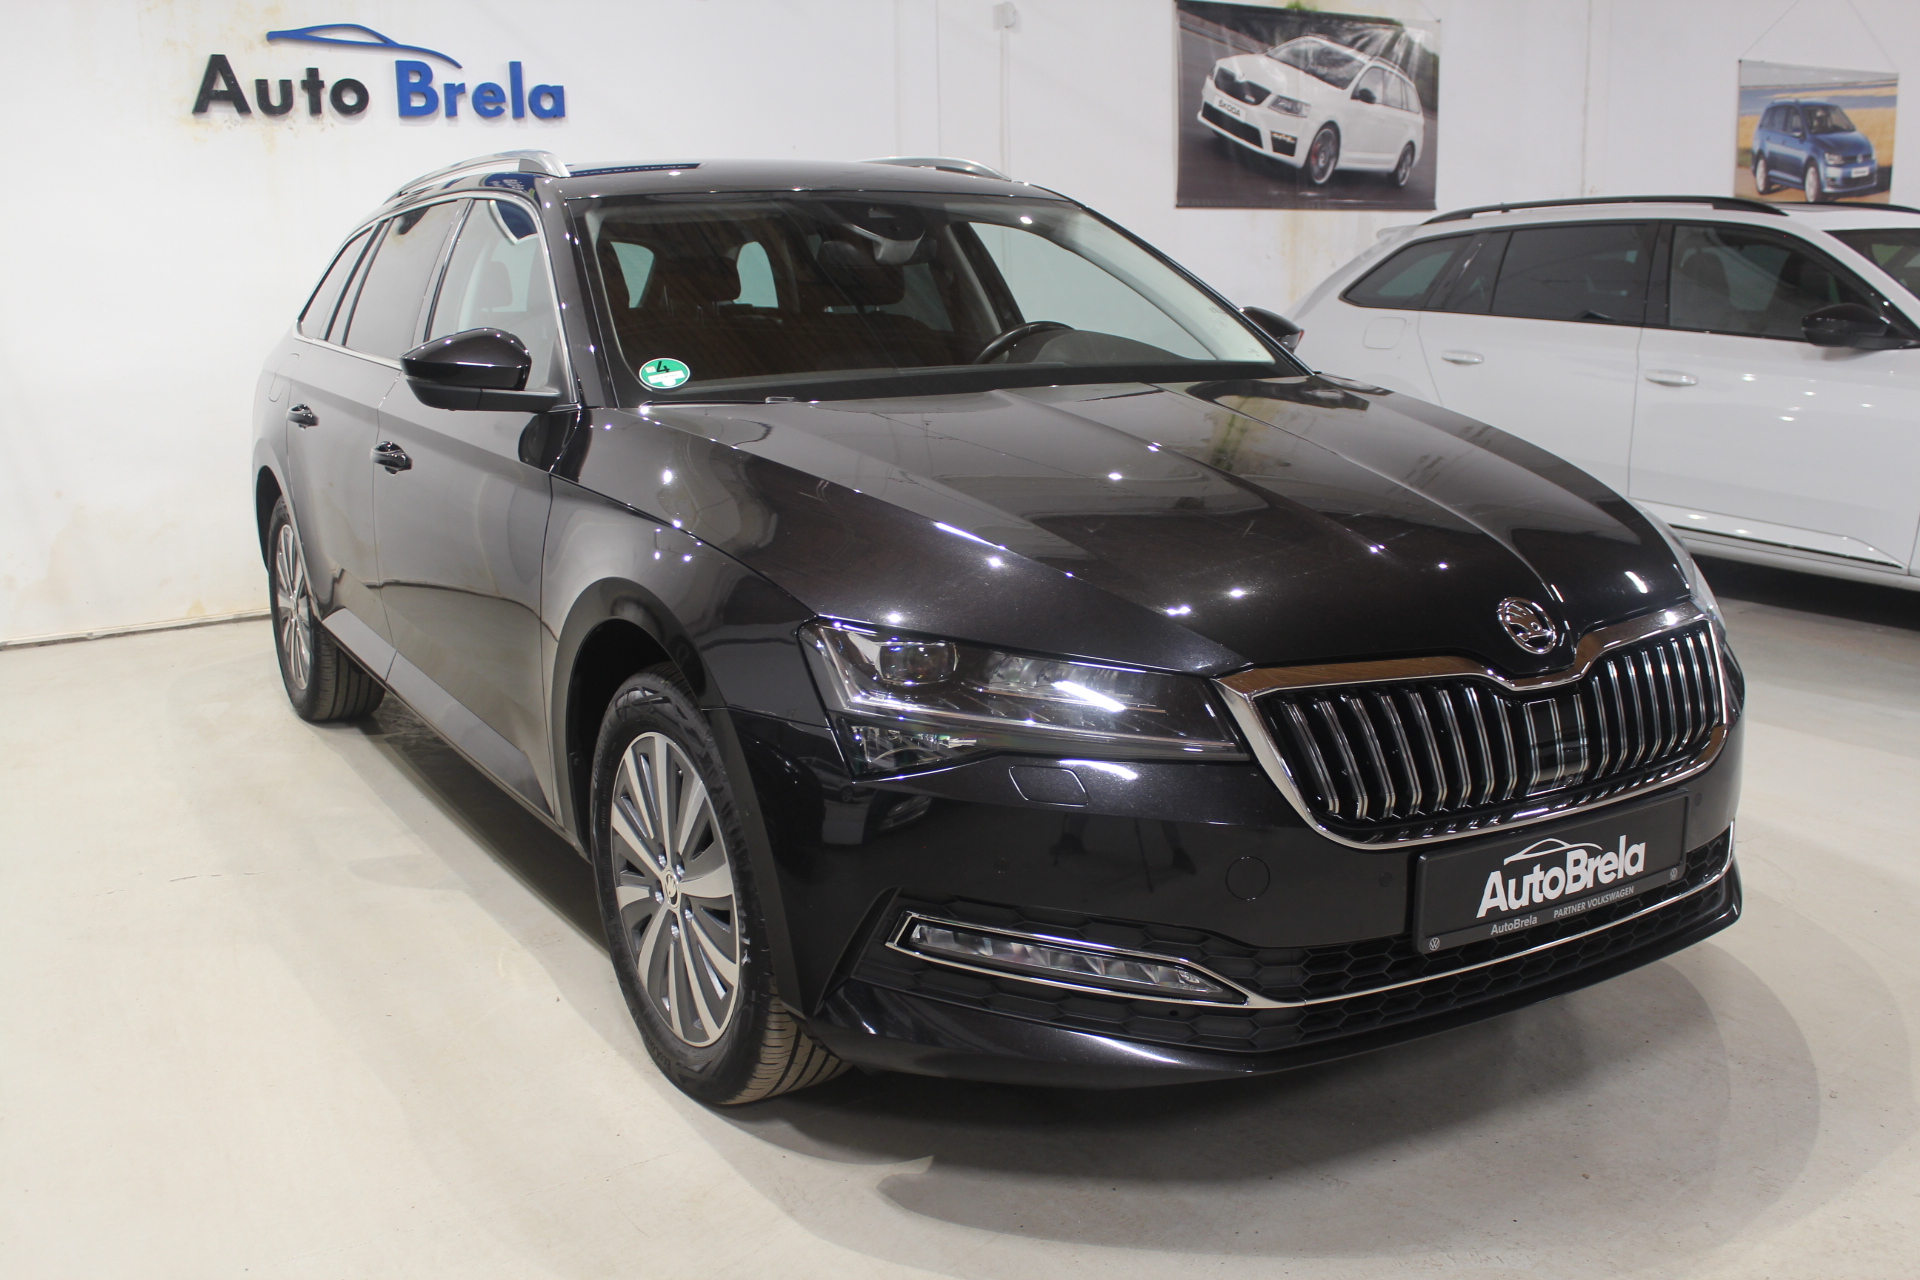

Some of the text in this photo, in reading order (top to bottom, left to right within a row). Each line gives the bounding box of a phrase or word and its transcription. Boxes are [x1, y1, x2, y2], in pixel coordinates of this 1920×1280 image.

[192, 54, 566, 119] Auto Brela
[656, 360, 670, 373] 4
[1476, 835, 1646, 919] AutoBrela
[1553, 885, 1635, 919] PARTNER VOLKSWAGEN
[1490, 915, 1538, 936] AutoBrela
